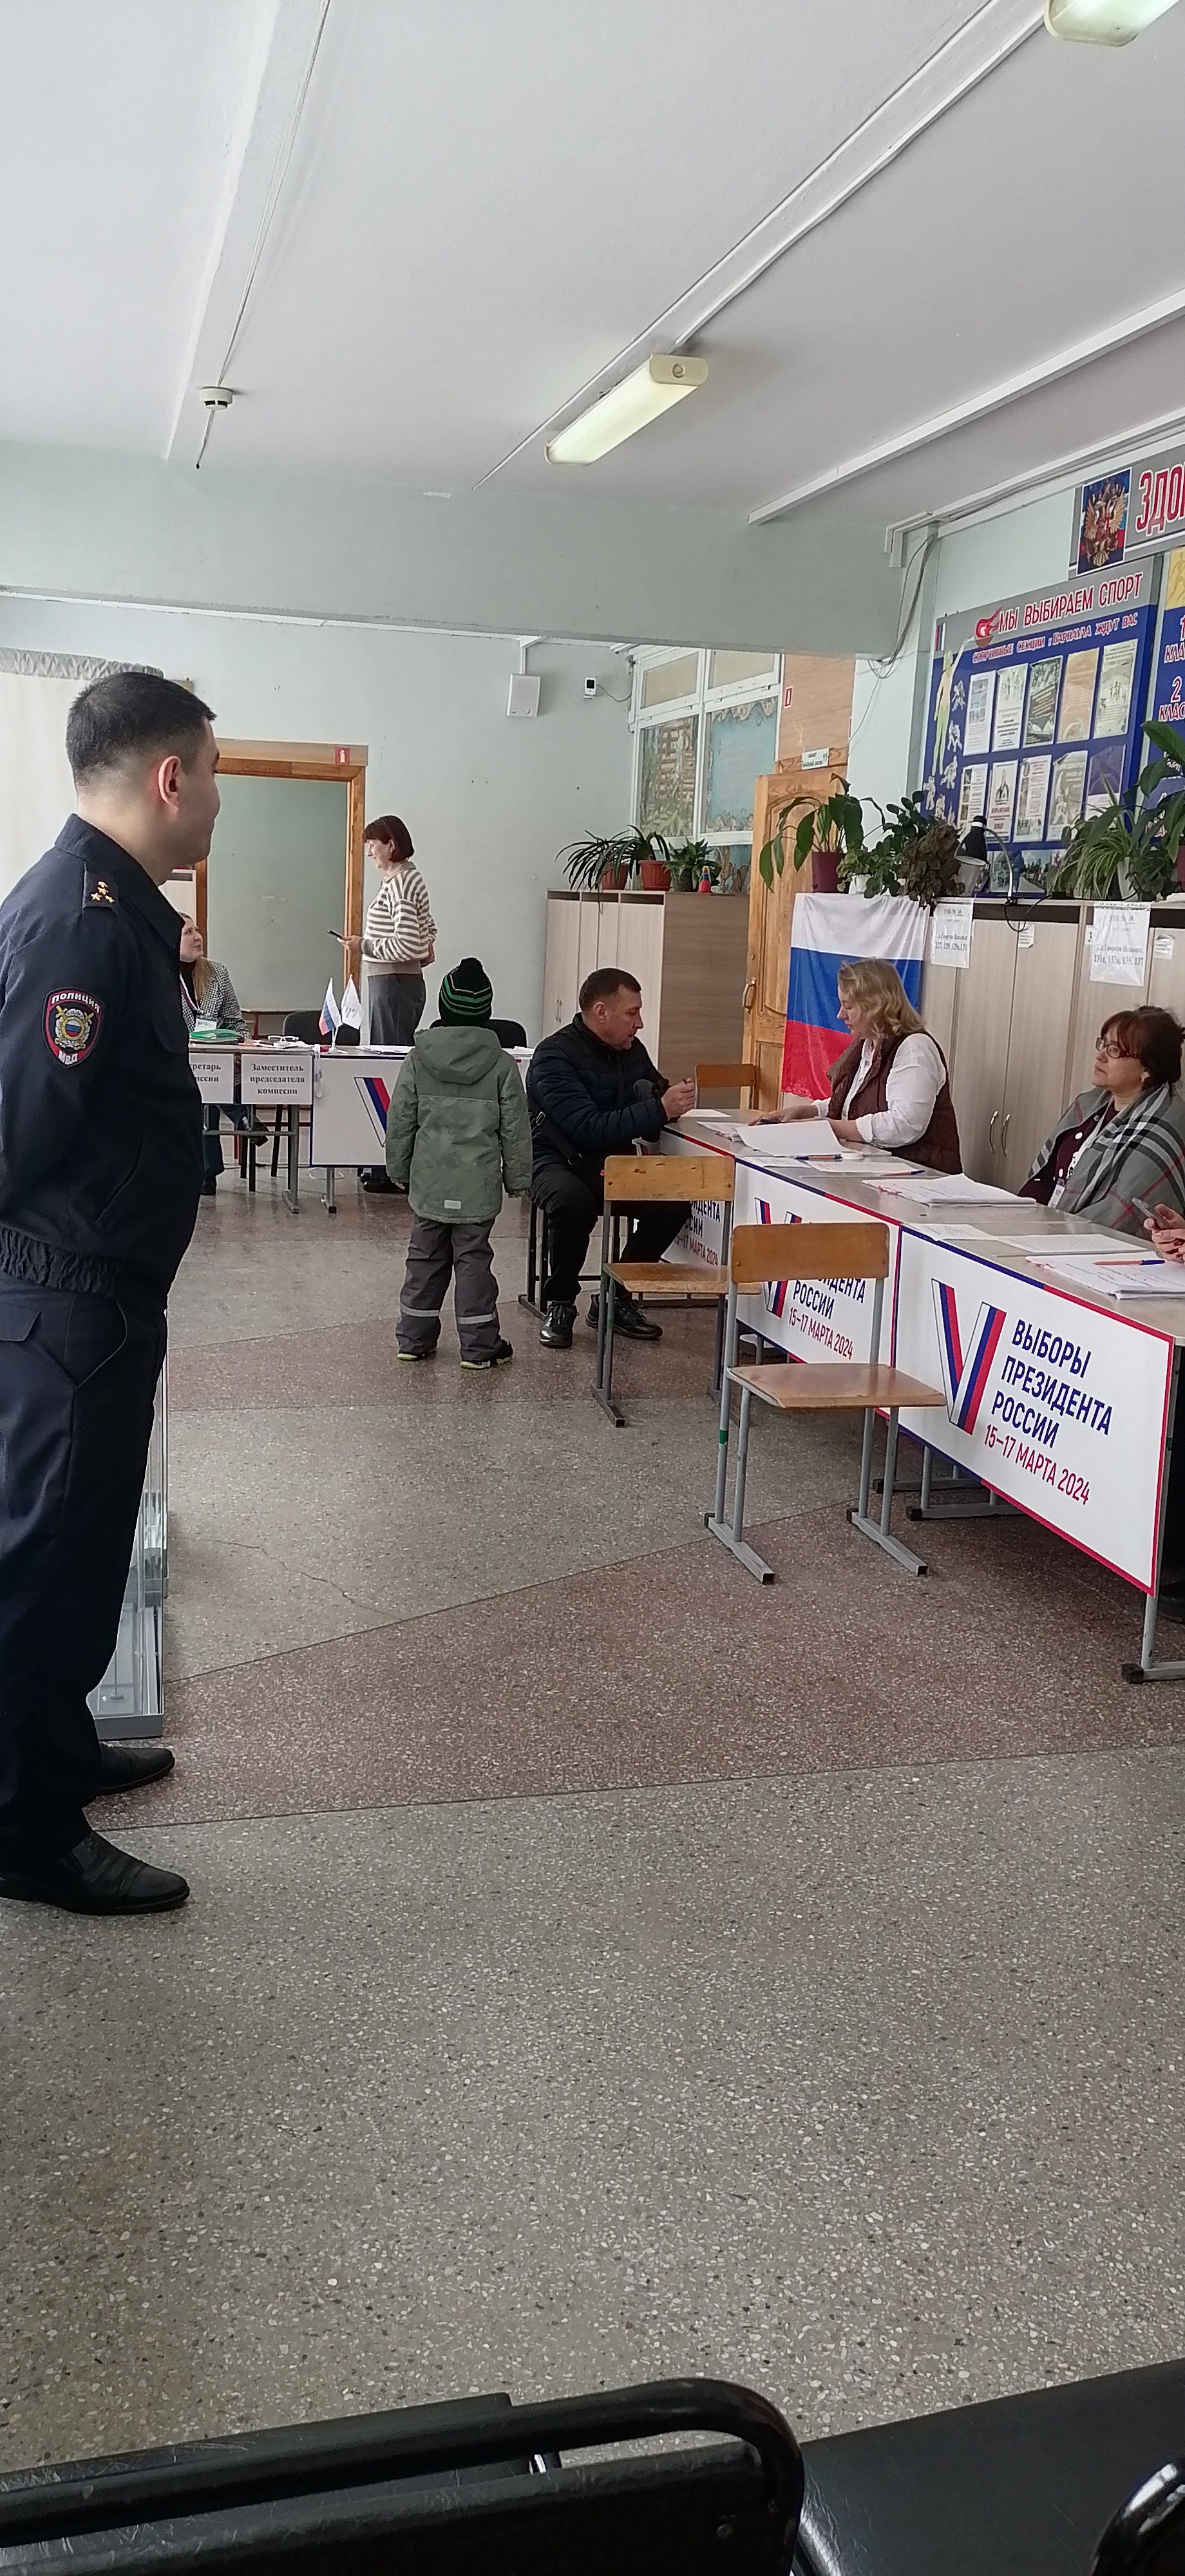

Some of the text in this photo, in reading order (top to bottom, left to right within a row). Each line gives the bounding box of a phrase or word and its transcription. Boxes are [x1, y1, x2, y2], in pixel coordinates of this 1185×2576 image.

[1136, 462, 1185, 536] ЗДО
[998, 571, 1143, 634] МЫ ВЫБИРАЕМ СПОРТ
[972, 643, 1014, 663] СПОРТИВНЫЕ
[1017, 637, 1045, 652] СЕКЦИИ
[1052, 625, 1092, 645] БАРНАУЛА
[1095, 618, 1120, 636] ЖДУТ
[1122, 612, 1138, 629] ВАС
[1170, 676, 1182, 703] 2
[52, 992, 100, 1013] ПОЛИЦИЯ
[59, 1050, 78, 1065] МВД
[251, 1063, 304, 1072] Заместитель
[690, 1236, 706, 1260] МАРТА
[706, 1247, 719, 1265] 2024
[793, 1280, 835, 1320] РОССИИ
[808, 1318, 833, 1349] МАРТА
[834, 1334, 853, 1359] 2024
[1012, 1319, 1091, 1378] ВЫБОРЫ
[1001, 1355, 1113, 1435] ПРЕЗИДЕНТА
[992, 1390, 1059, 1448] РОССИИ
[1016, 1443, 1057, 1486] МАРТА
[1057, 1468, 1090, 1505] 2024
